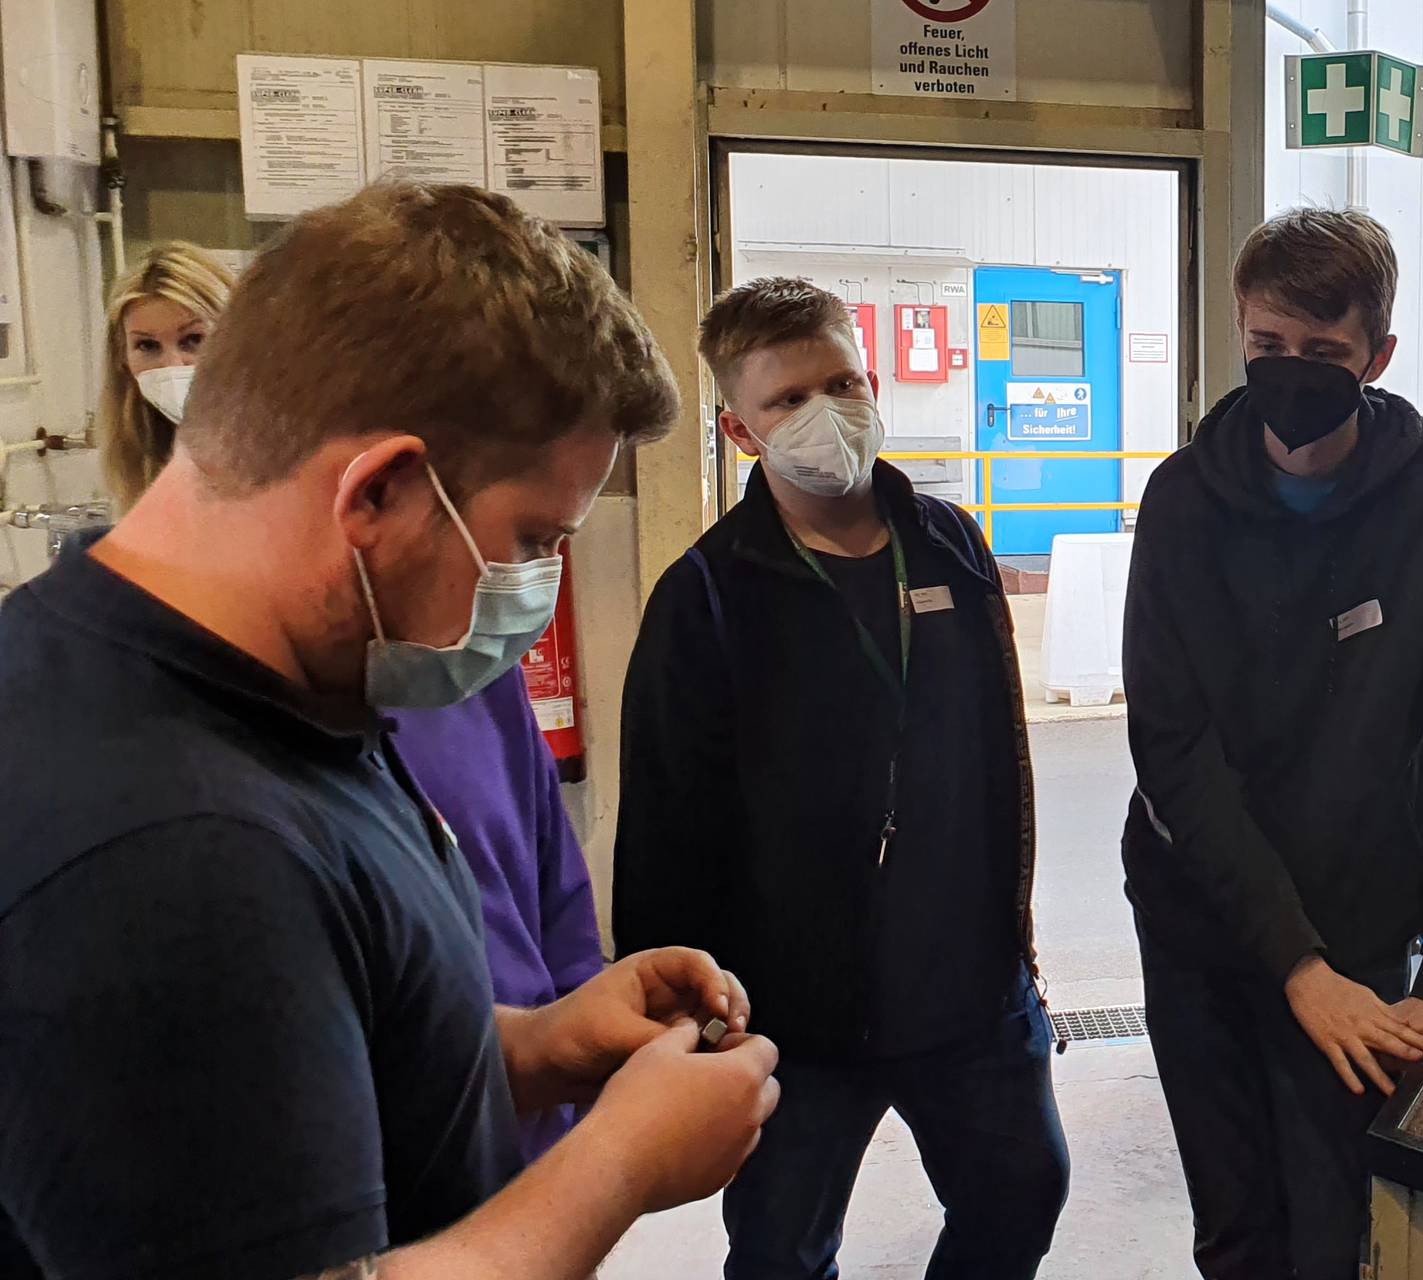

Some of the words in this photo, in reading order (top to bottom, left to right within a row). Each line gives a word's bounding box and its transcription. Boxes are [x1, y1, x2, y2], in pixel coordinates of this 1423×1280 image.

[923, 25, 965, 41] Feuer,
[900, 42, 951, 56] offenes
[955, 44, 989, 59] Licht
[900, 60, 925, 73] und
[929, 61, 989, 77] Rauchen
[914, 79, 975, 94] verboten
[944, 285, 965, 293] RWA
[1034, 407, 1048, 418] für
[1056, 407, 1077, 419] Ihre
[1023, 424, 1076, 435] Sicherheit!
